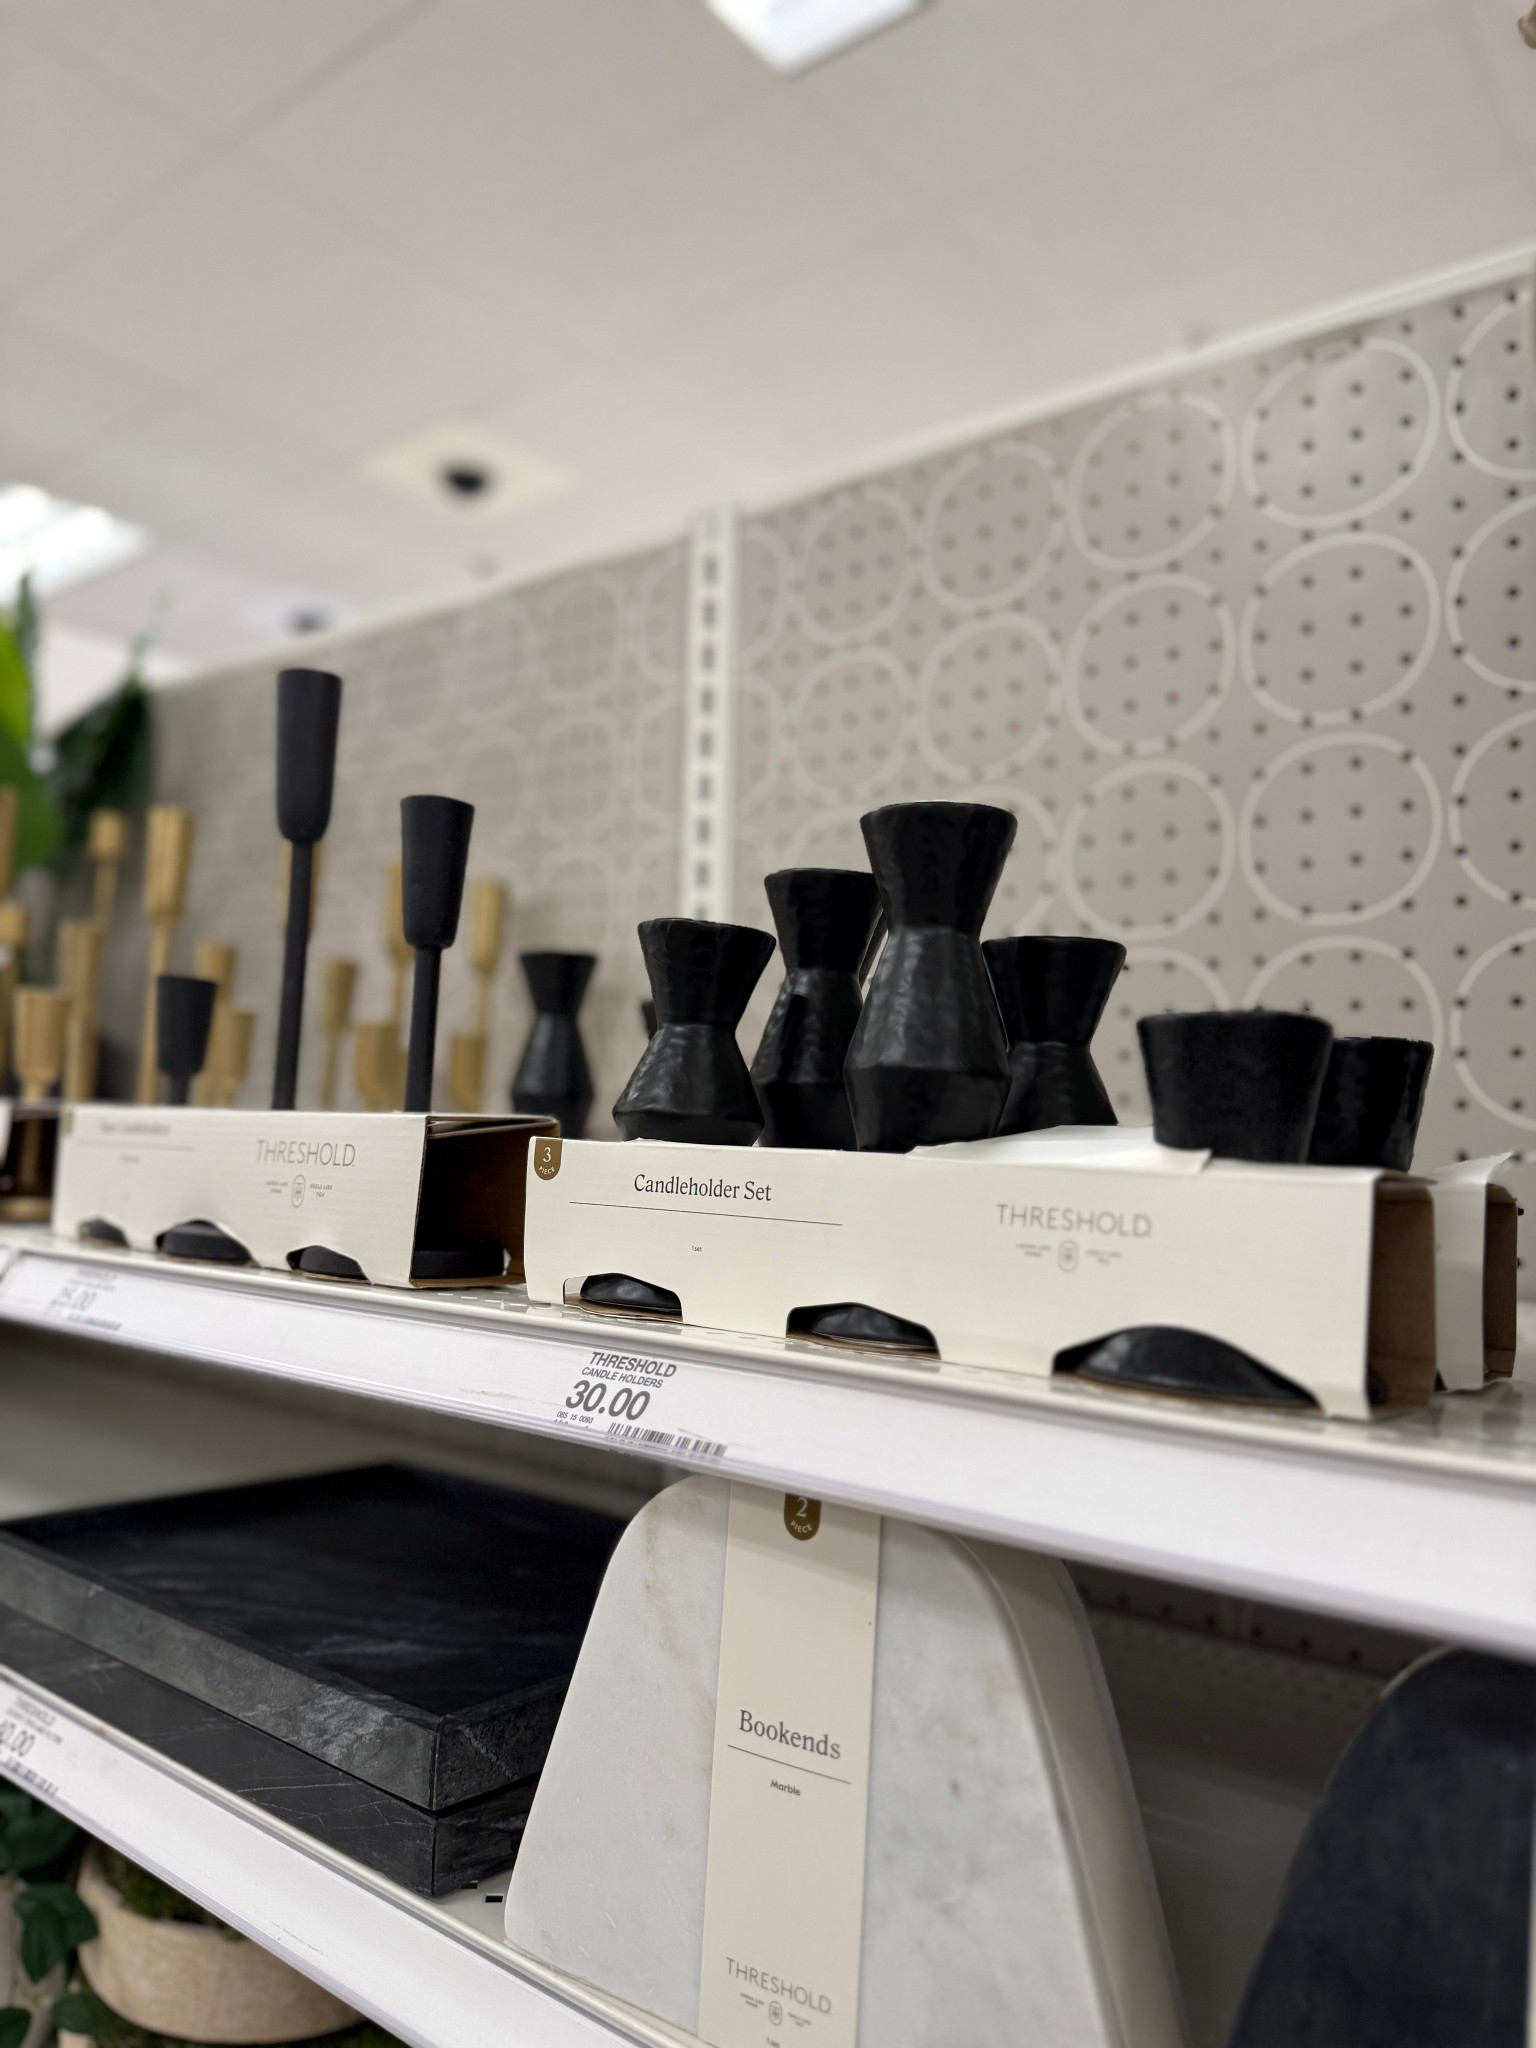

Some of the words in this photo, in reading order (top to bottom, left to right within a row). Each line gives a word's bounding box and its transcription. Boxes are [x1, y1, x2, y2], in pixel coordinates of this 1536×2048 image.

[542, 1146, 552, 1163] 3
[538, 1166, 556, 1175] PIECE
[634, 1173, 741, 1199] Candleholder
[743, 1180, 773, 1202] Set
[996, 1203, 1152, 1238] THRESHOLD
[588, 1351, 677, 1378] THRESHOLD
[581, 1366, 619, 1381] CANDLE
[618, 1373, 664, 1389] HOLDERS
[565, 1379, 651, 1421] 30.00
[796, 1497, 808, 1518] 2
[790, 1520, 813, 1533] PIECE
[739, 1709, 841, 1760] Bookends
[770, 1779, 801, 1796] Marble
[726, 1956, 832, 2014] THRESHOLD
